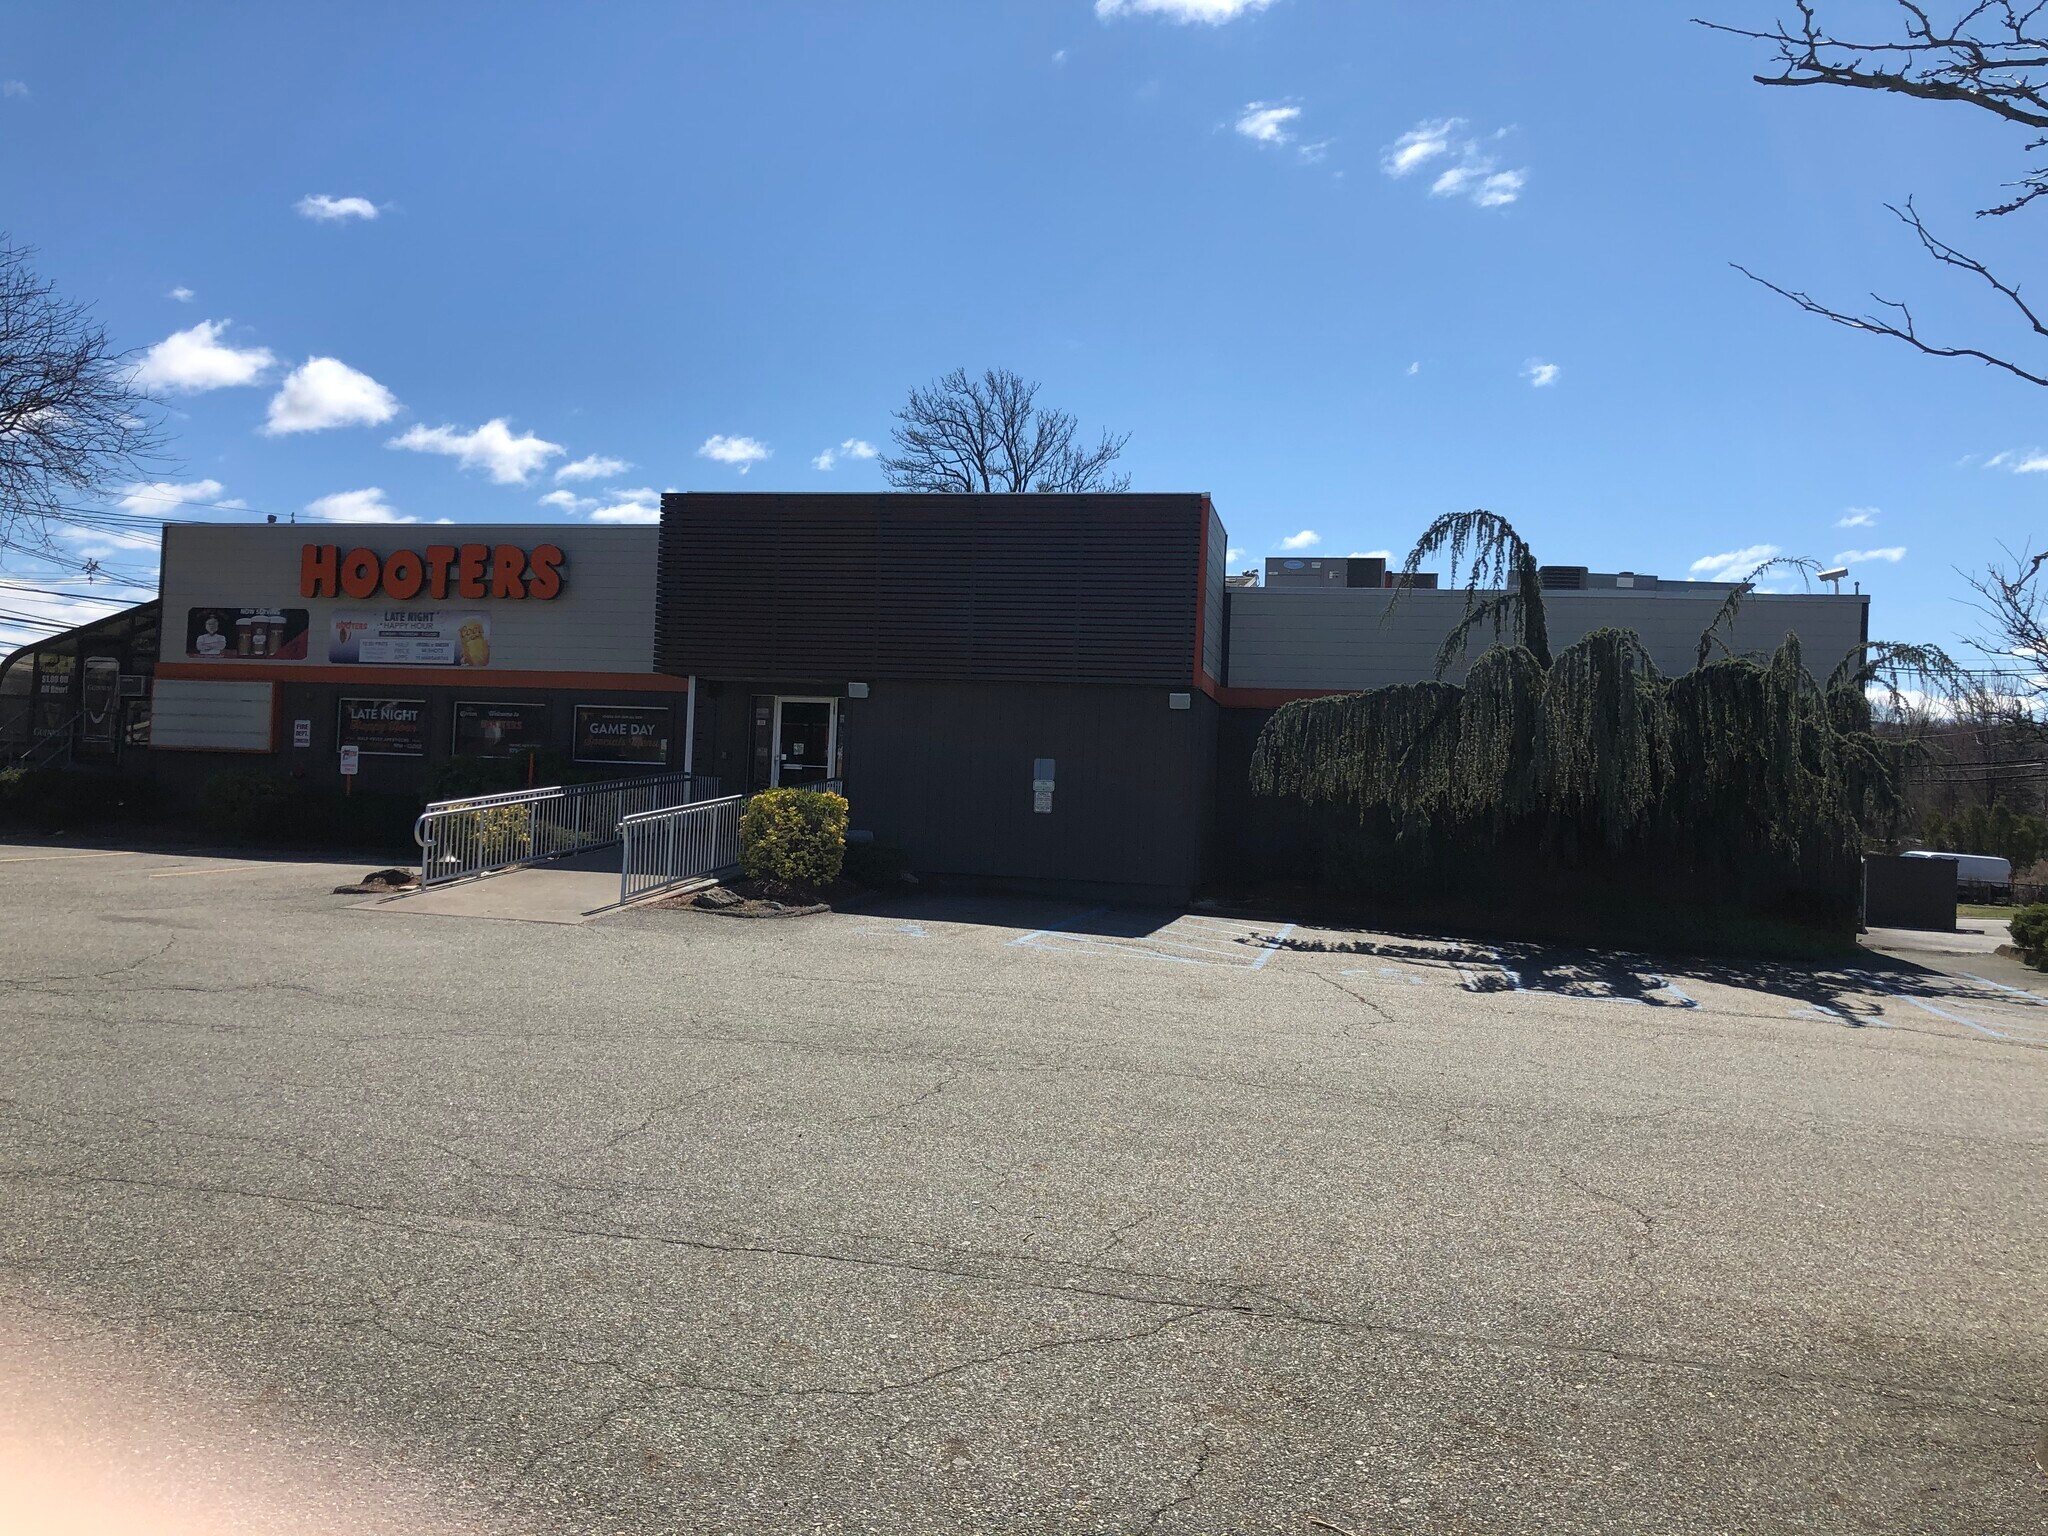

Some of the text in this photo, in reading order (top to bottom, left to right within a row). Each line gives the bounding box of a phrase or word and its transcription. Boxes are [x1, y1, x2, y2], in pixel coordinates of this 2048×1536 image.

[300, 543, 567, 600] HOOTERS
[384, 611, 435, 622] LATE NIGHT
[410, 622, 434, 630] HOUR
[351, 708, 418, 721] LATE NIGHT
[589, 722, 656, 736] GAME DAY
